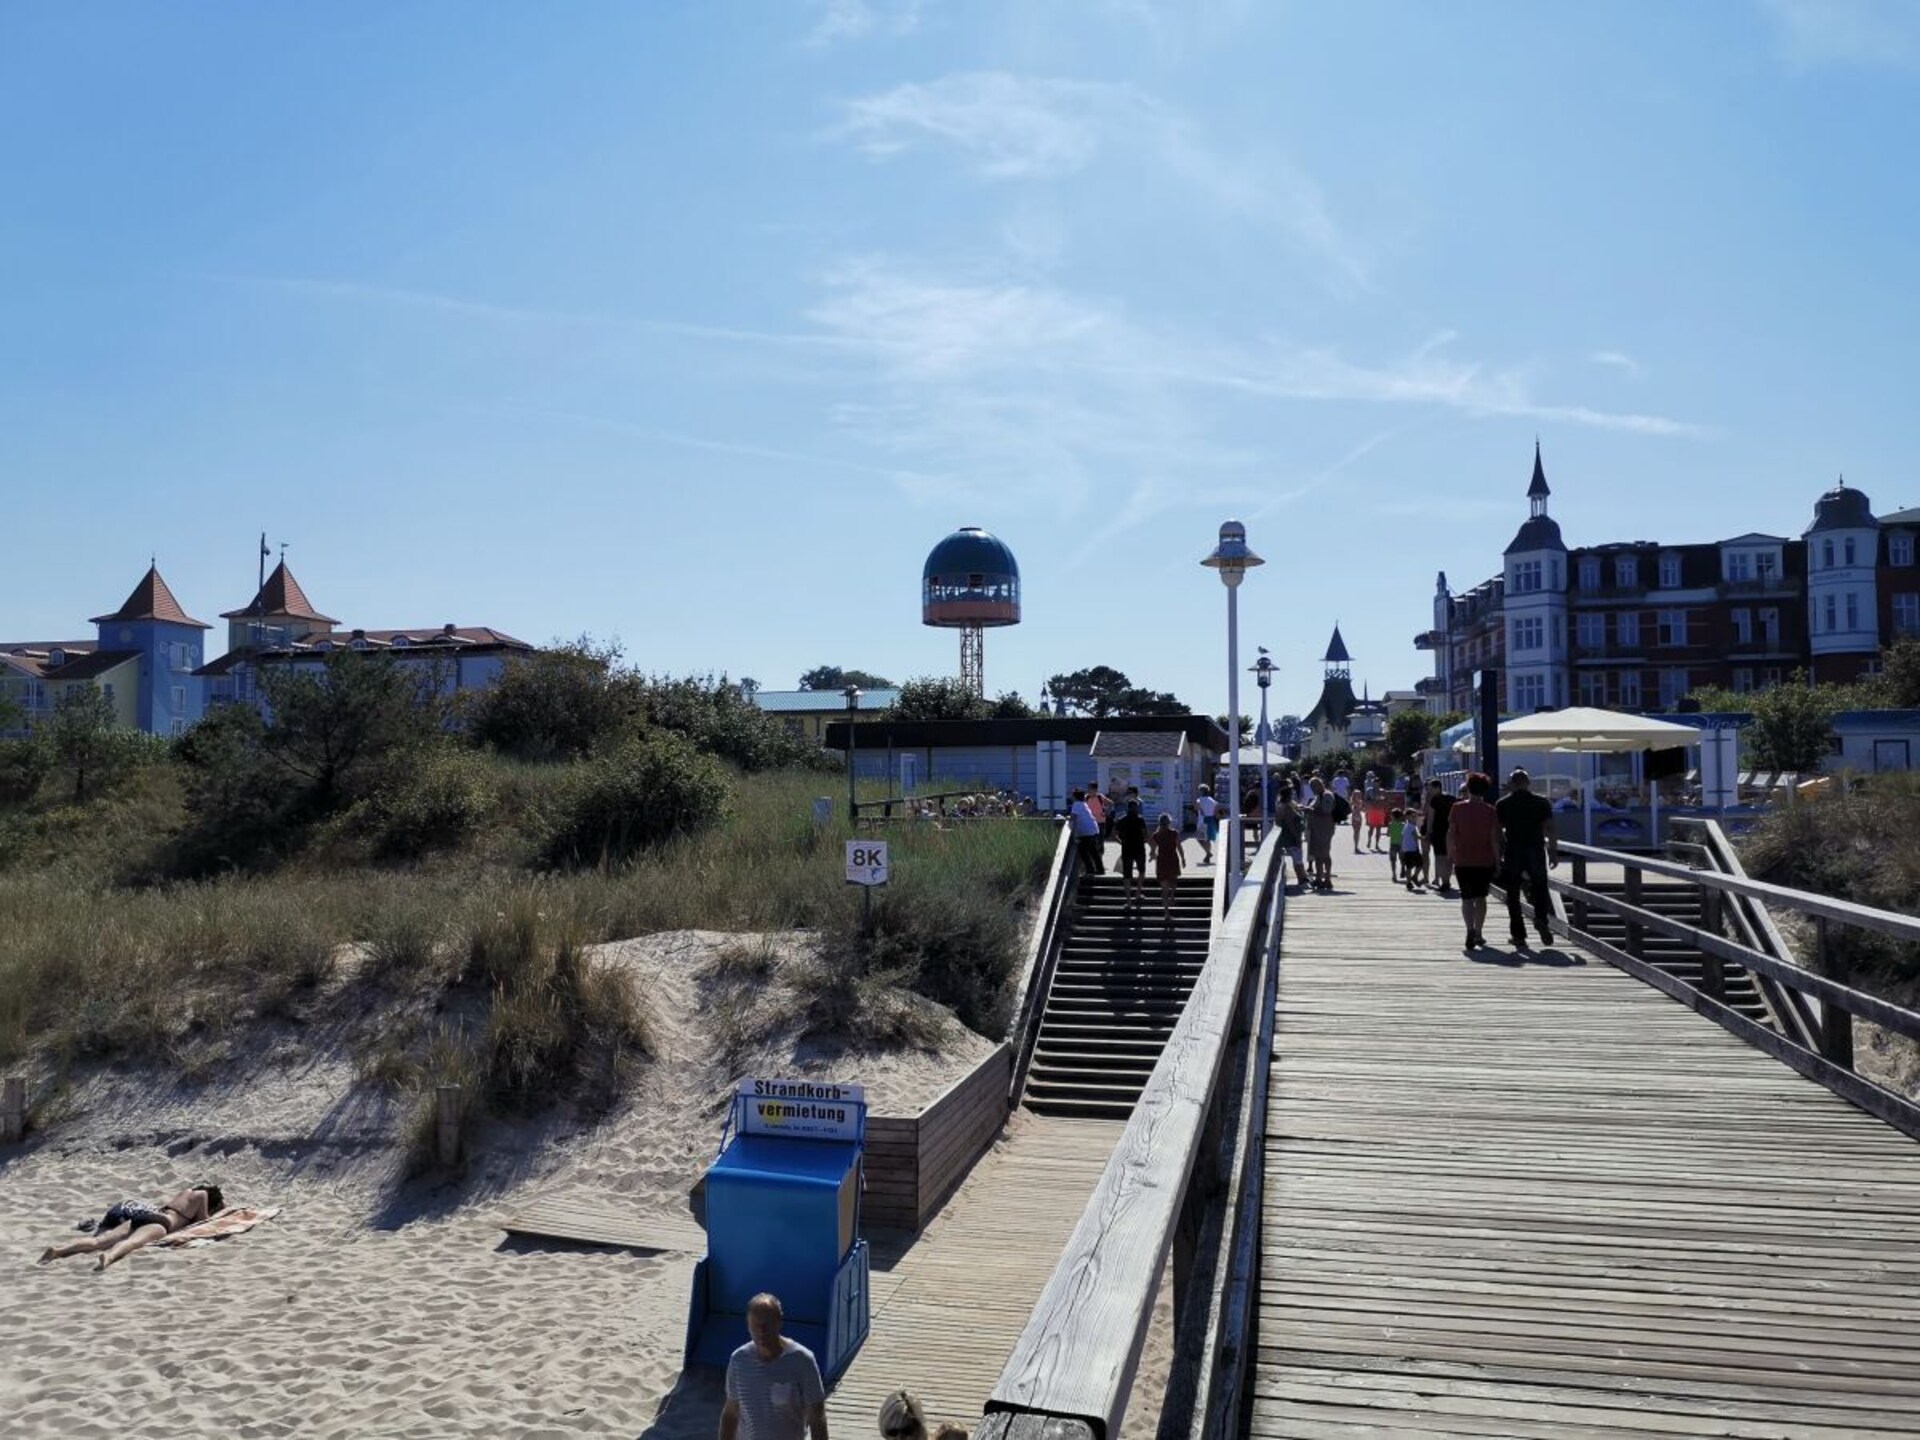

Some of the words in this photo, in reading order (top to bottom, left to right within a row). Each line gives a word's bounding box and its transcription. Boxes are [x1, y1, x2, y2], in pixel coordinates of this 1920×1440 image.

[853, 849, 882, 866] 8K
[754, 1080, 850, 1100] Strandkorb-
[757, 1103, 846, 1123] vermietung
